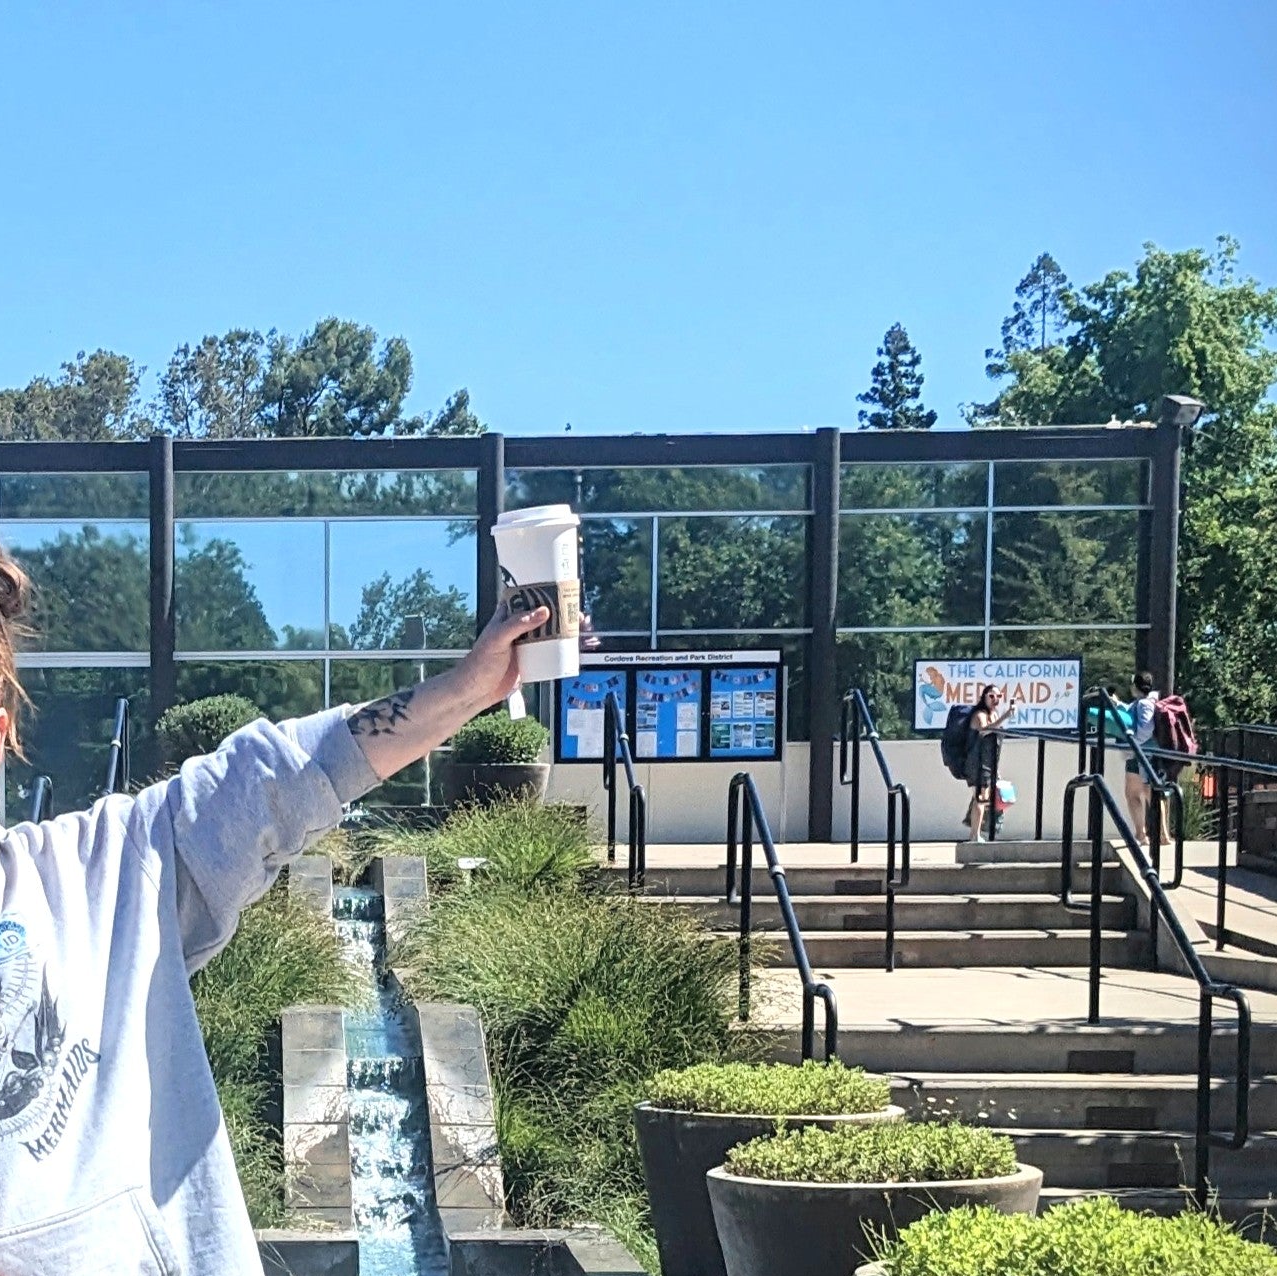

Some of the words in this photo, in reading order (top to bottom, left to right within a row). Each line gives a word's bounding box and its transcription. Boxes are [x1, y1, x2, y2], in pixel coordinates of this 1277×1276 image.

[947, 664, 977, 678] THE
[983, 663, 1078, 678] CALIFORNIA
[2, 934, 20, 947] ID
[17, 1037, 101, 1163] MERMAIDS
